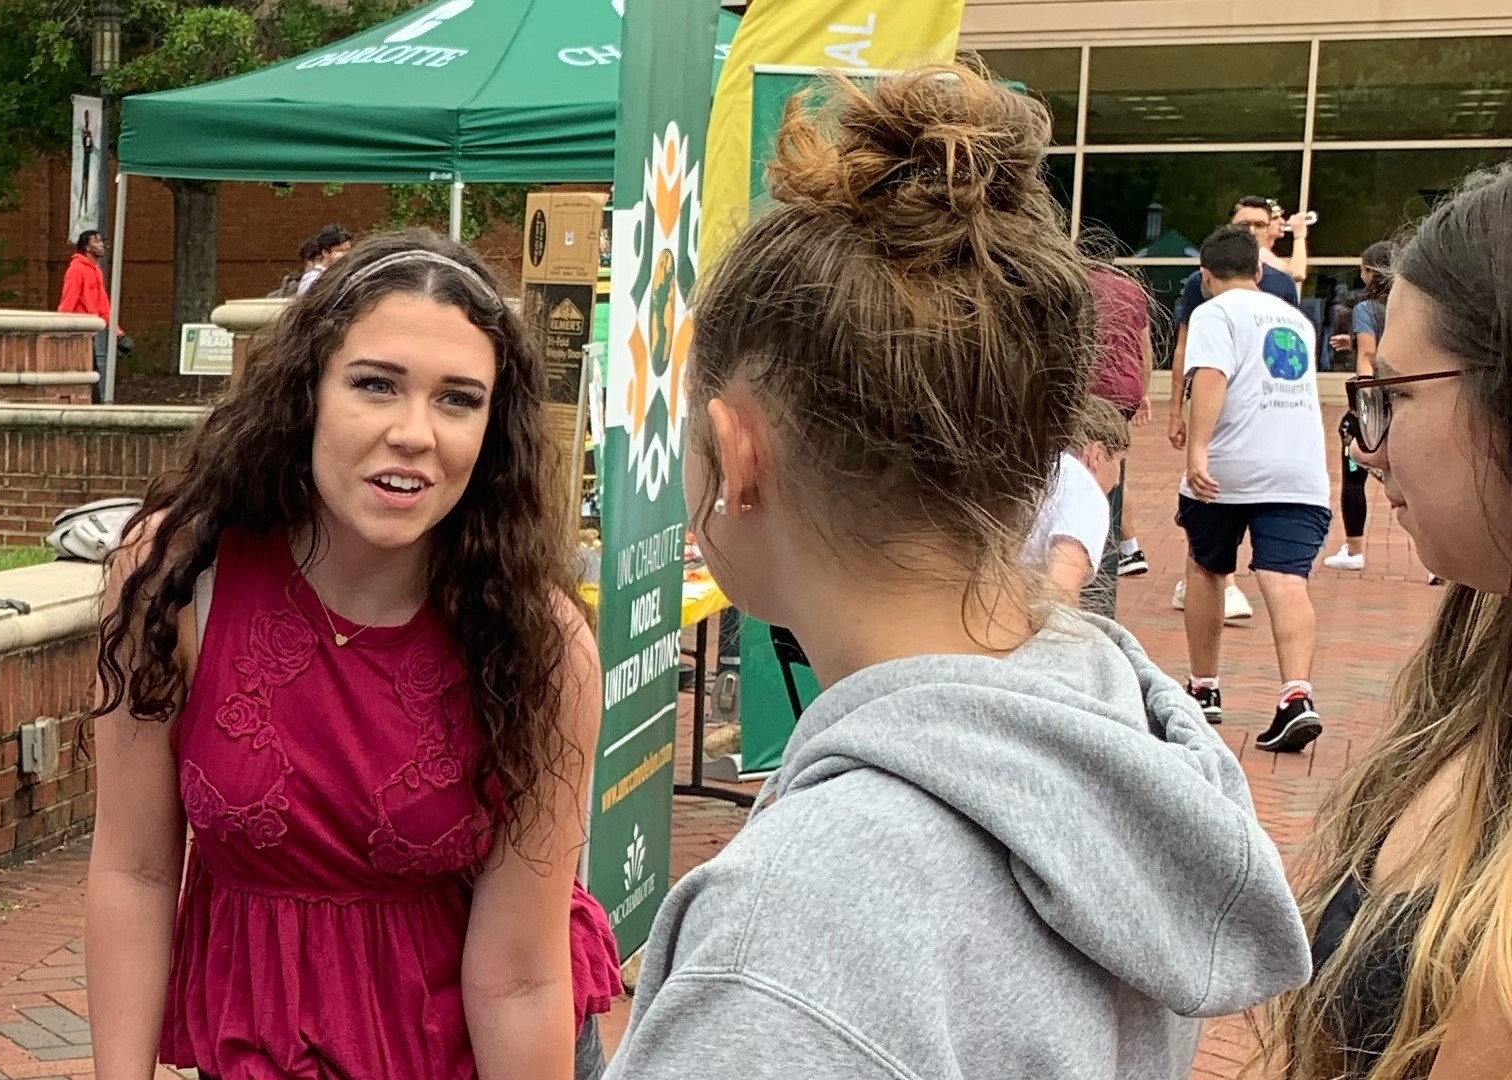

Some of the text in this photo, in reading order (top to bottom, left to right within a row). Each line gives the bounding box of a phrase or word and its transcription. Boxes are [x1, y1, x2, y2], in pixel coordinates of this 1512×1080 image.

[296, 44, 469, 70] CHARLOTTE
[550, 317, 581, 331] ELMER'S
[617, 523, 683, 590] UNC CHARLOTTE
[630, 586, 661, 639] MODEL
[605, 628, 681, 710] UNITED NATIONS
